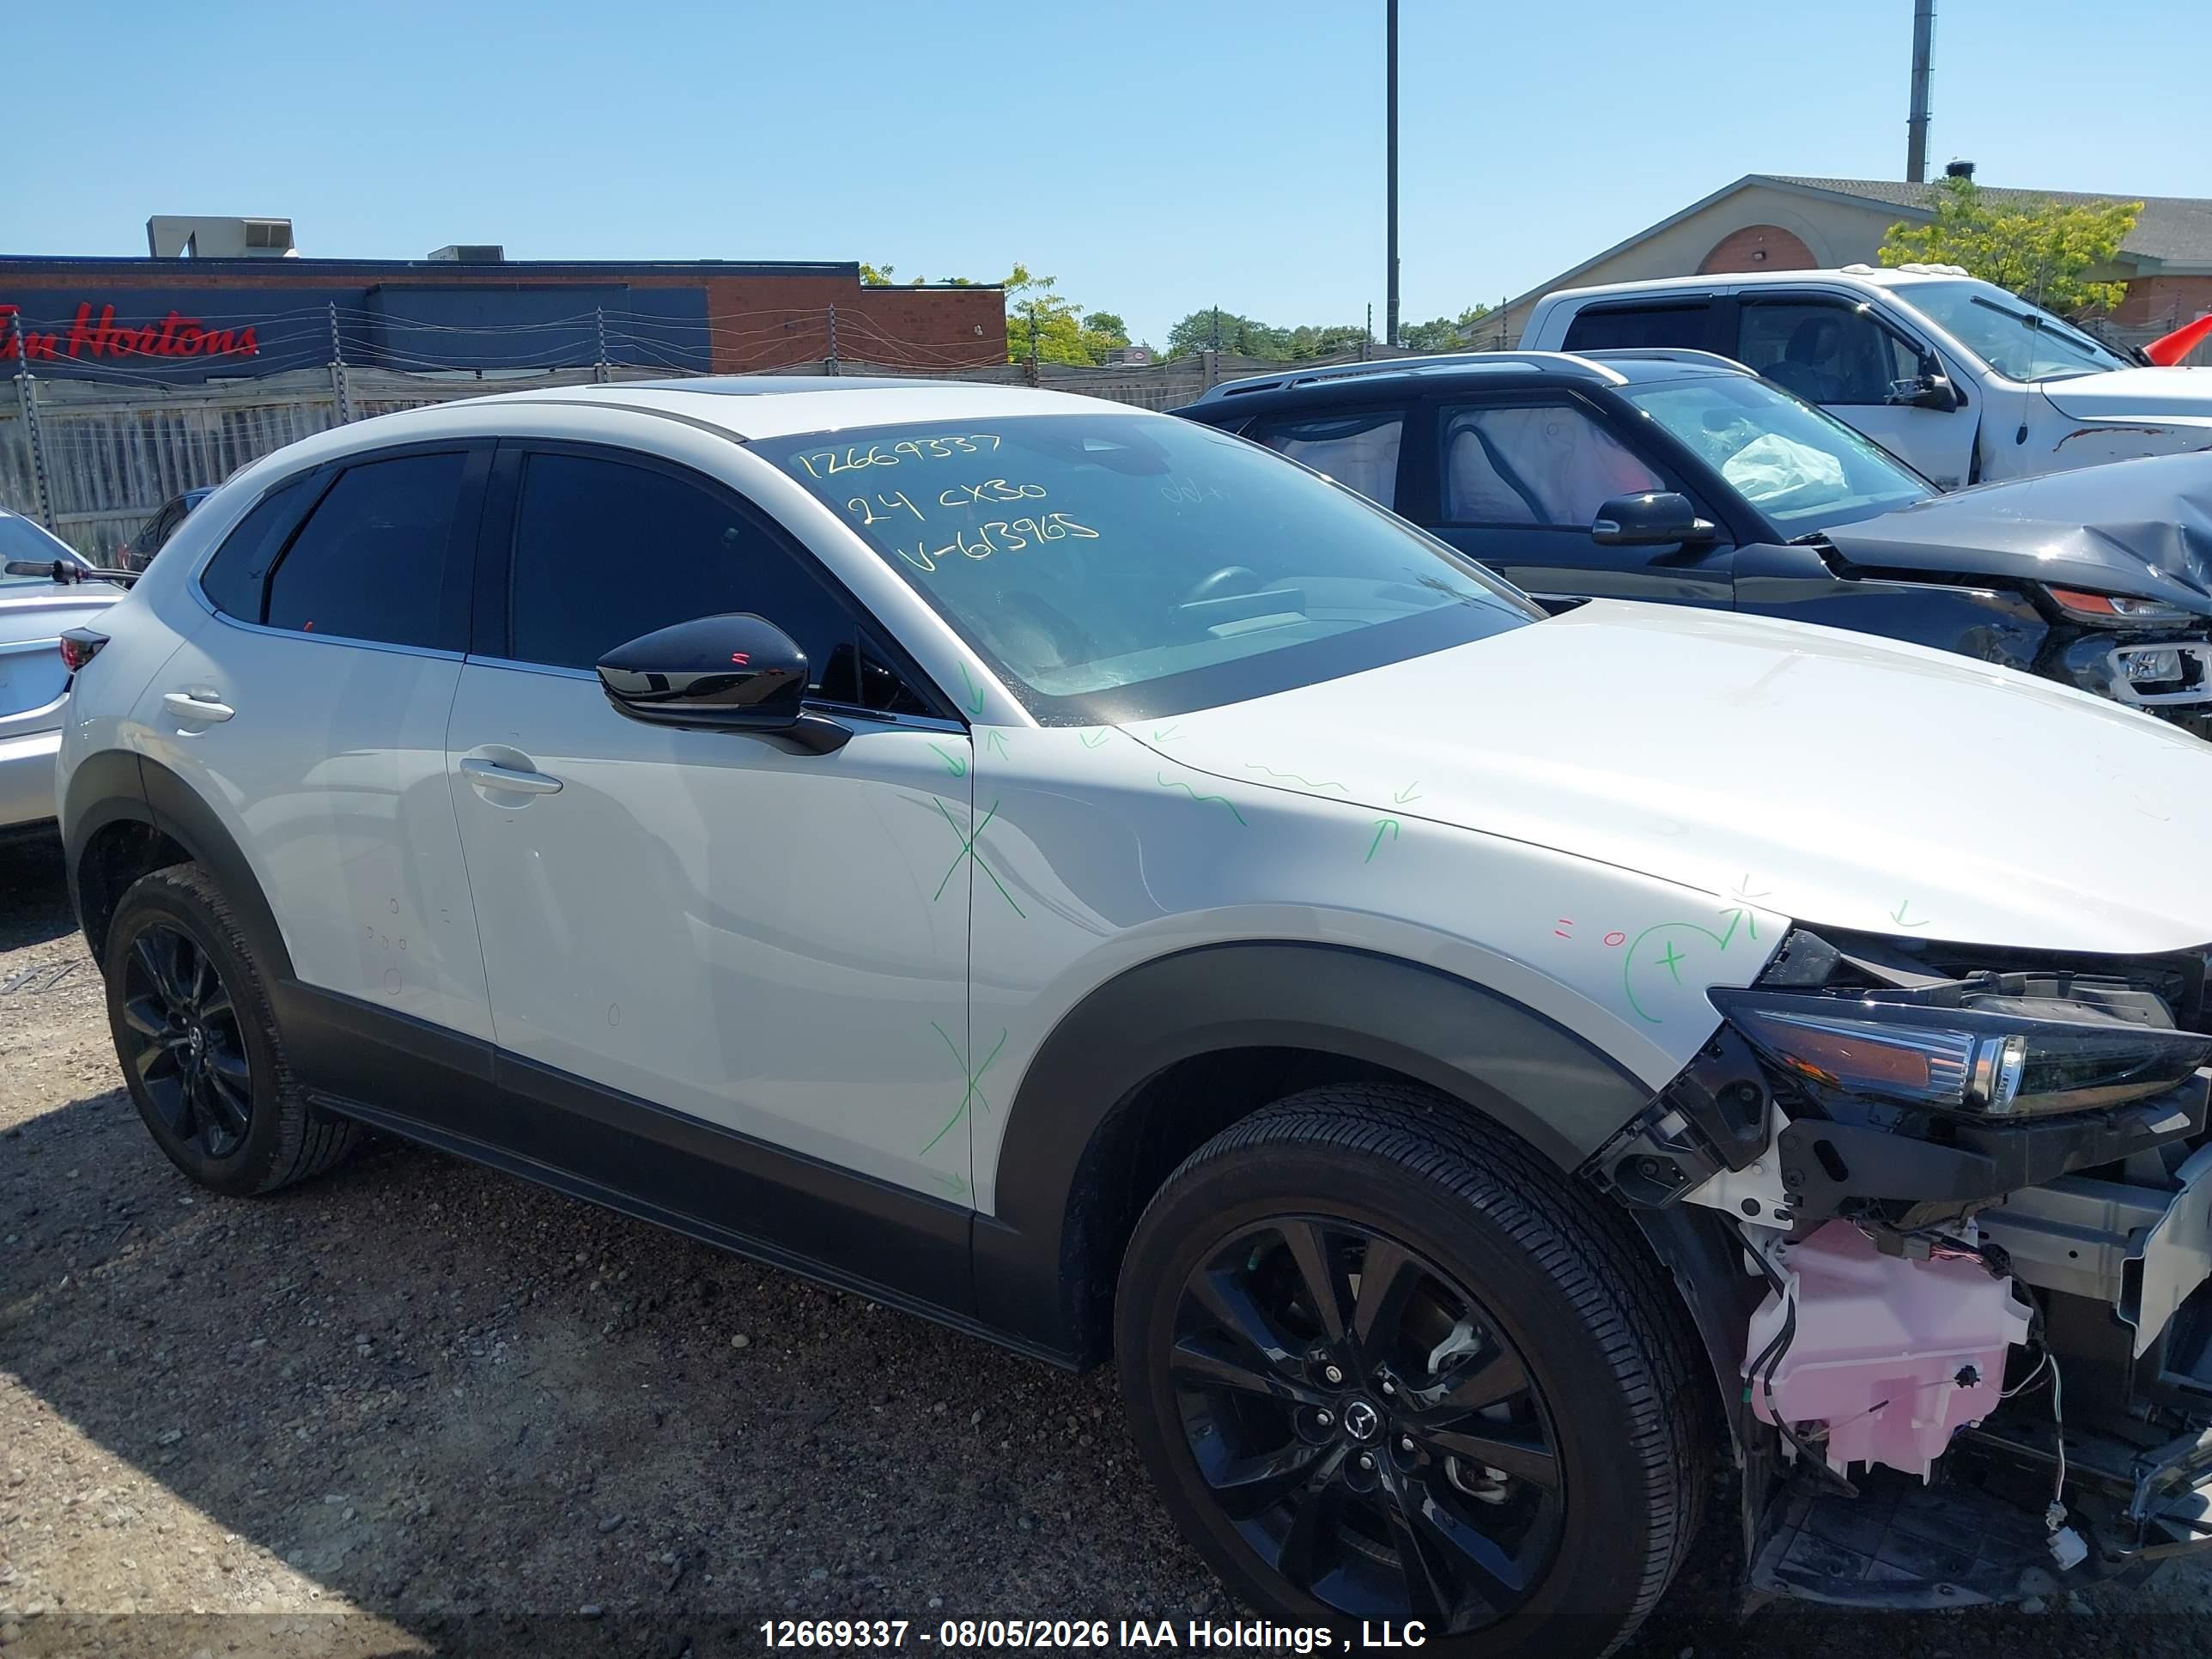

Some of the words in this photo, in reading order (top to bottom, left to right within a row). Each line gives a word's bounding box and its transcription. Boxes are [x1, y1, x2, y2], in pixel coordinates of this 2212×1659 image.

[65, 301, 258, 359] Hortons
[799, 434, 1001, 479] 12669337
[847, 490, 927, 525] 24
[897, 512, 1101, 573] V-613965
